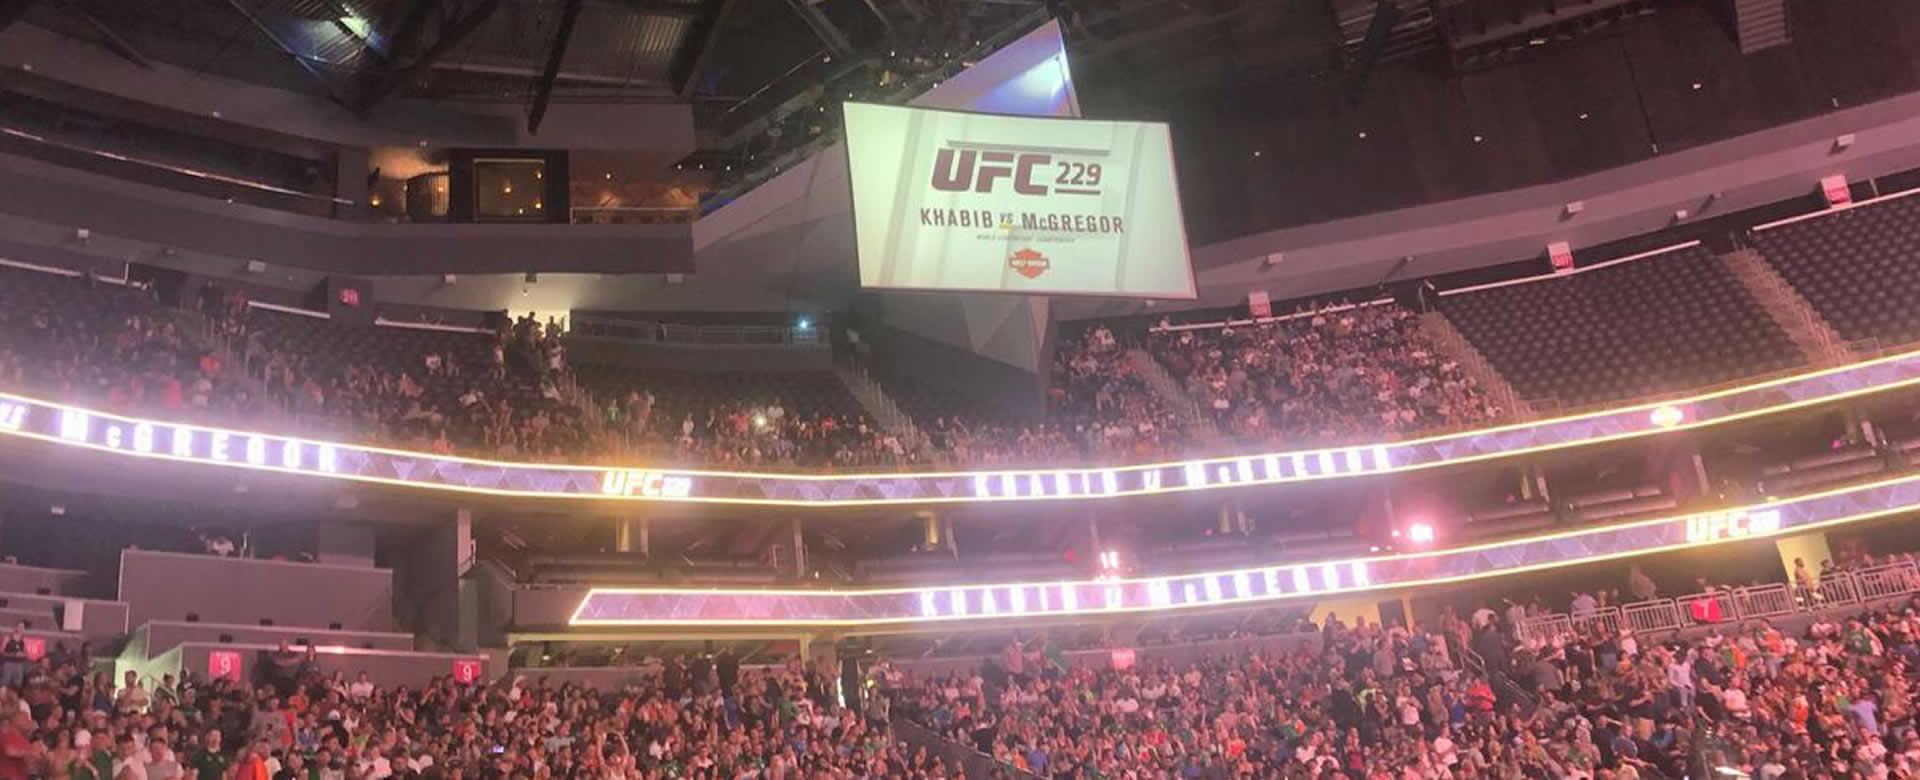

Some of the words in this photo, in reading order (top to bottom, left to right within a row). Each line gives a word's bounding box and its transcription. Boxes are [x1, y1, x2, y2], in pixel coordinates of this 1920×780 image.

[931, 148, 1052, 196] UFC
[1055, 161, 1102, 186] 229
[920, 207, 993, 229] KHABIB
[1022, 212, 1125, 234] McGREGOR
[602, 470, 664, 497] UFC
[1687, 509, 1750, 543] UFC
[463, 664, 472, 682] 9
